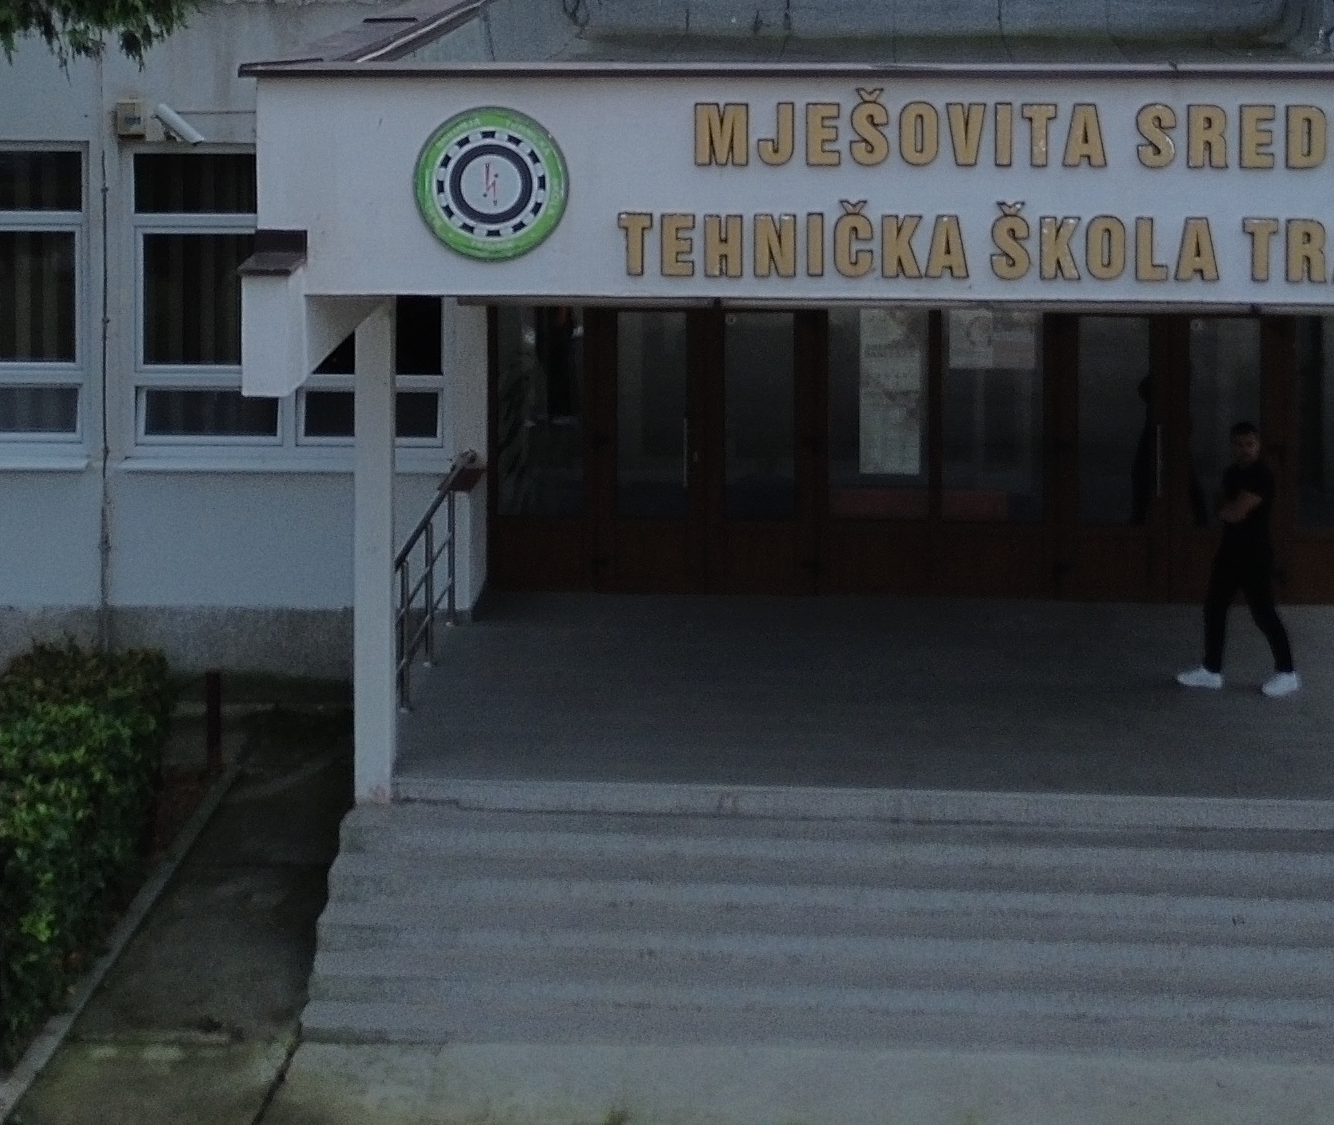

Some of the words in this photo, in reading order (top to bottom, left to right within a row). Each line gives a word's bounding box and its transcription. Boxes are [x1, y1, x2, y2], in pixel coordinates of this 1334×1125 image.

[694, 87, 1106, 167] MJEŠOVITA
[618, 200, 968, 279] TEHNIČKA
[990, 202, 1218, 281] ŠKOLA
